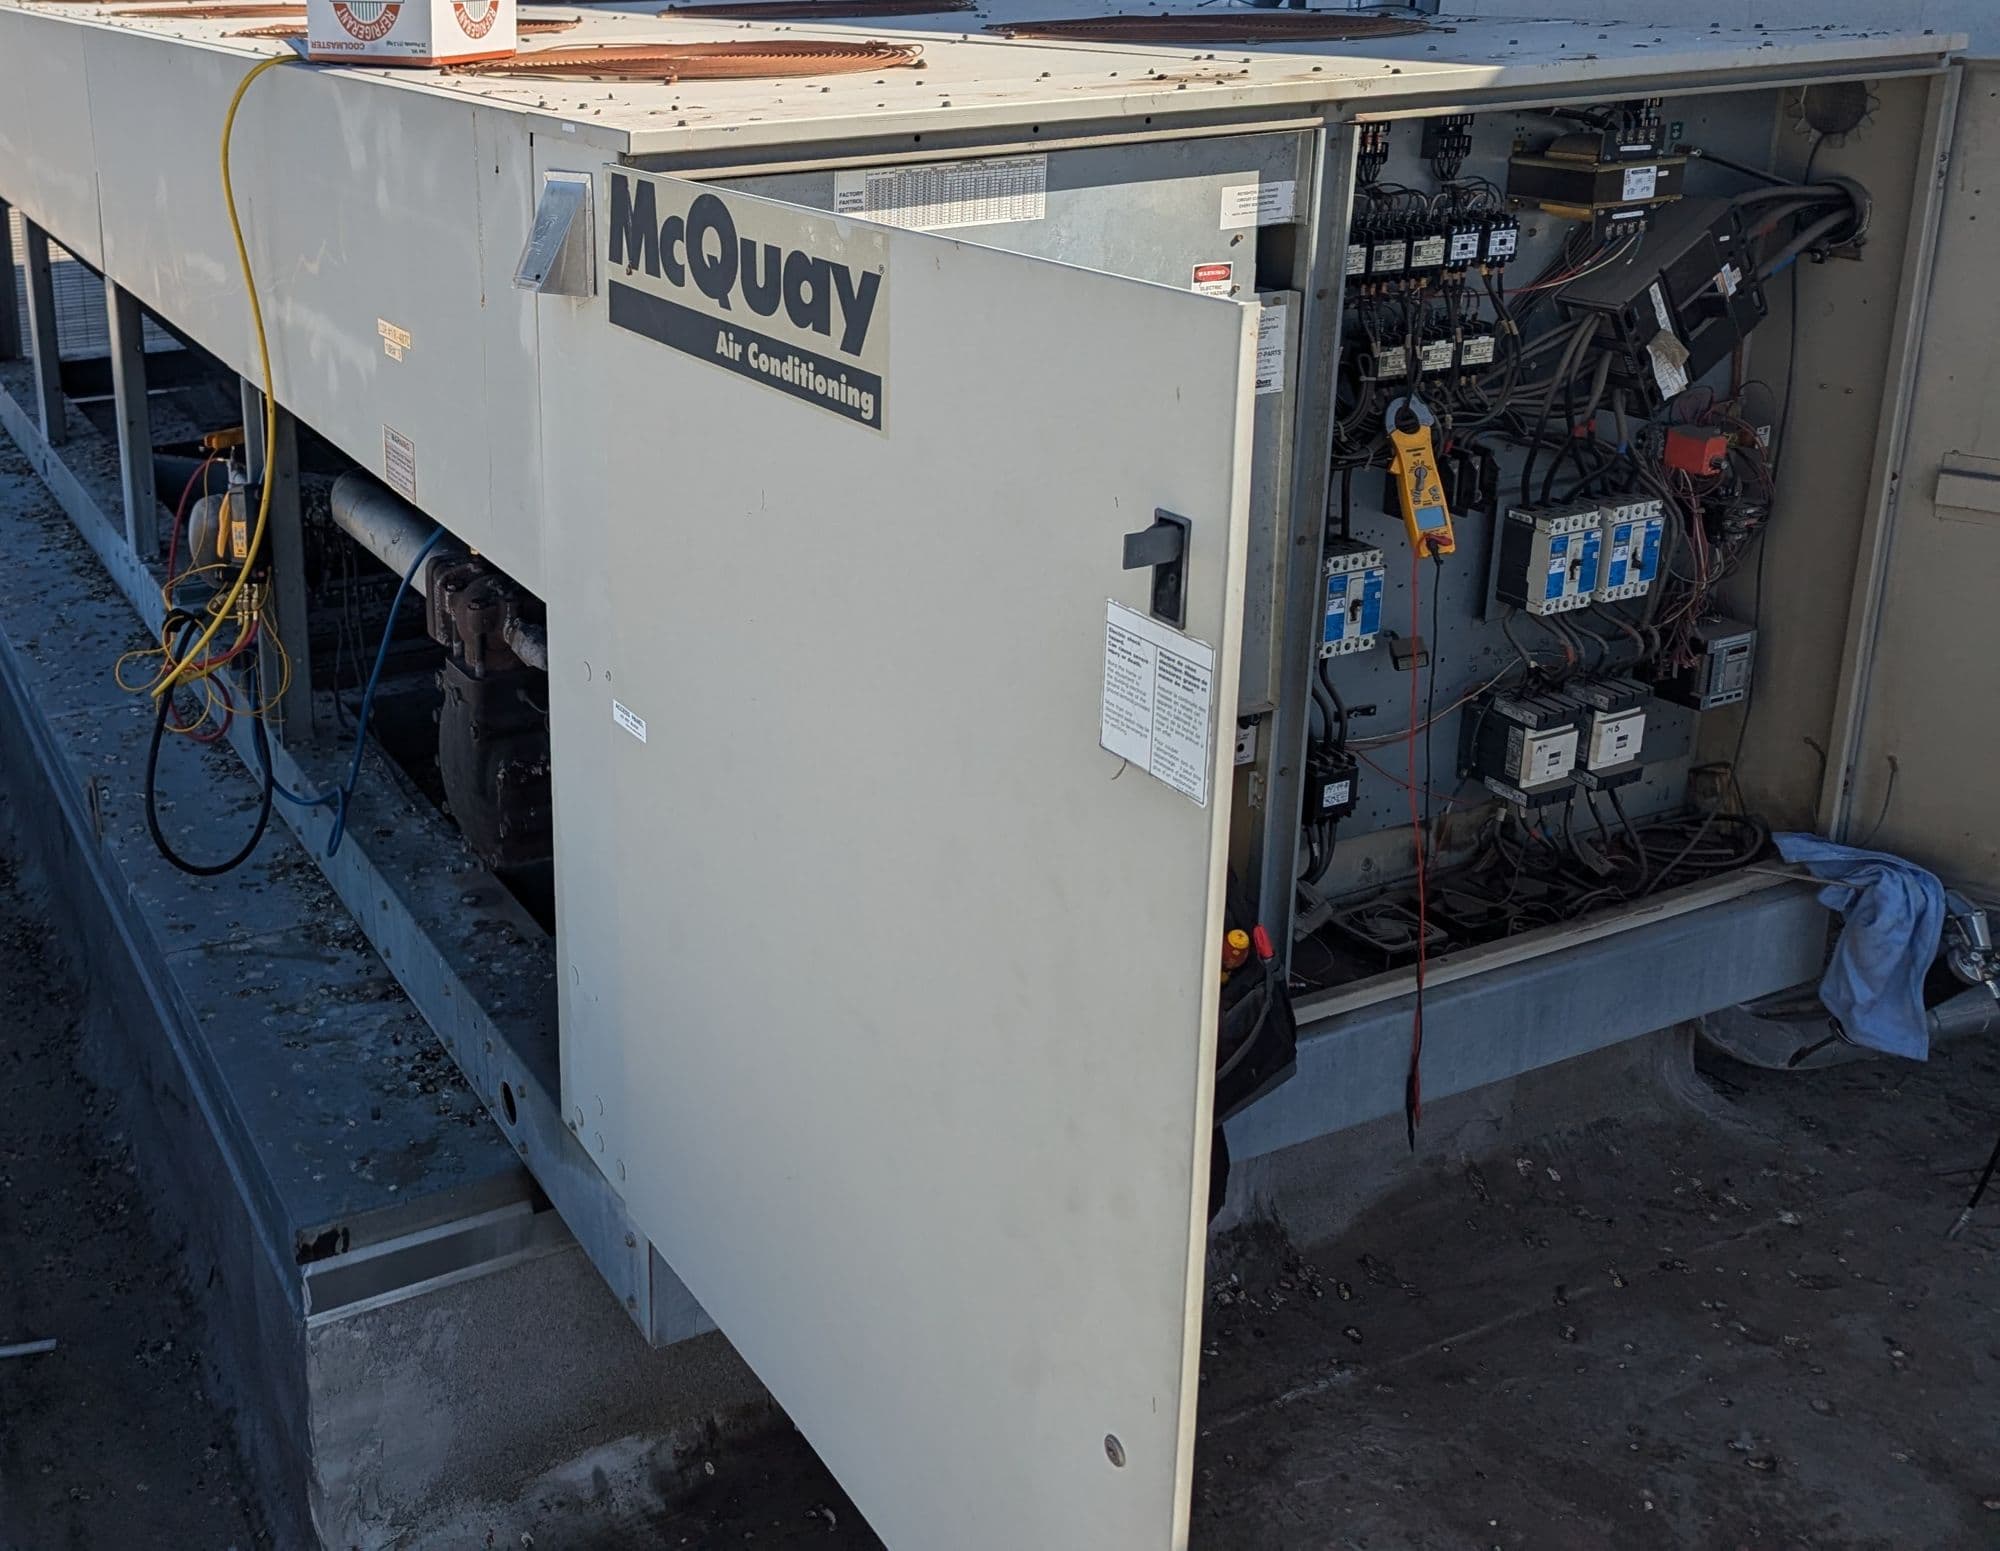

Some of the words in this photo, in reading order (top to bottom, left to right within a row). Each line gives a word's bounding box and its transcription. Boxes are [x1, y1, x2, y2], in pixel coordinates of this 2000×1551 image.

[337, 7, 396, 40] REFRIGERANT
[455, 7, 497, 38] REFRIGERANT
[311, 41, 365, 50] COOLMASTER
[608, 173, 881, 357] McQuay
[716, 331, 742, 362] Air
[747, 342, 874, 420] Conditioning
